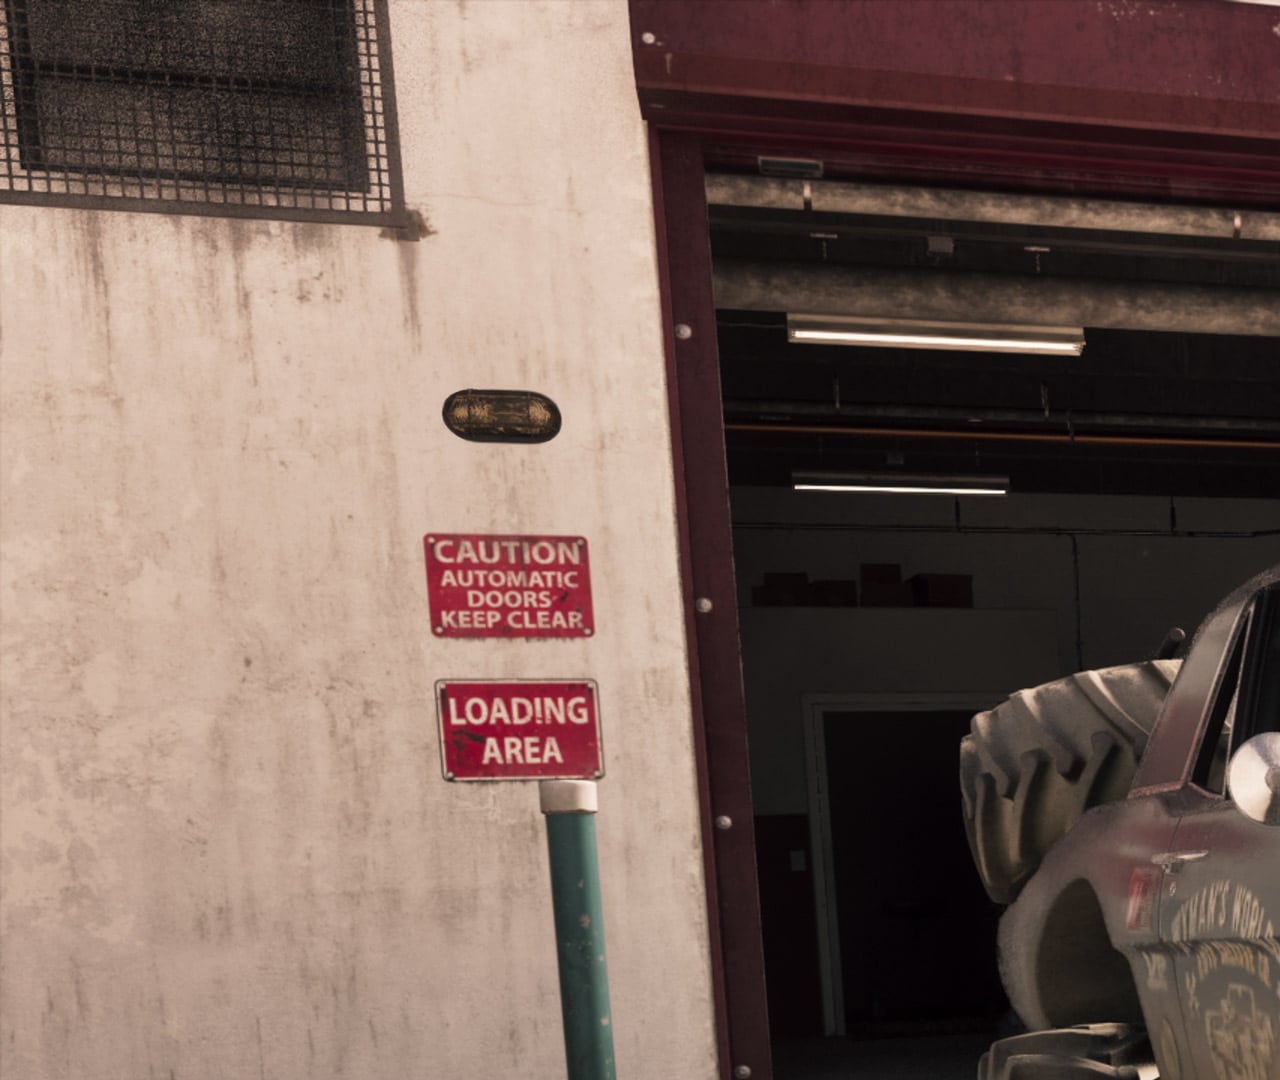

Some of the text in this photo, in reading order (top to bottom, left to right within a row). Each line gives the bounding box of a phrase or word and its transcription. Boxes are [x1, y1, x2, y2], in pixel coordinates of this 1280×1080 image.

[434, 540, 580, 565] CAUTION
[441, 570, 579, 588] AUTOMATIC
[467, 590, 552, 608] DOORS
[441, 610, 583, 629] KEEP CLEAR
[448, 697, 589, 725] LOADING
[482, 736, 564, 765] AREA
